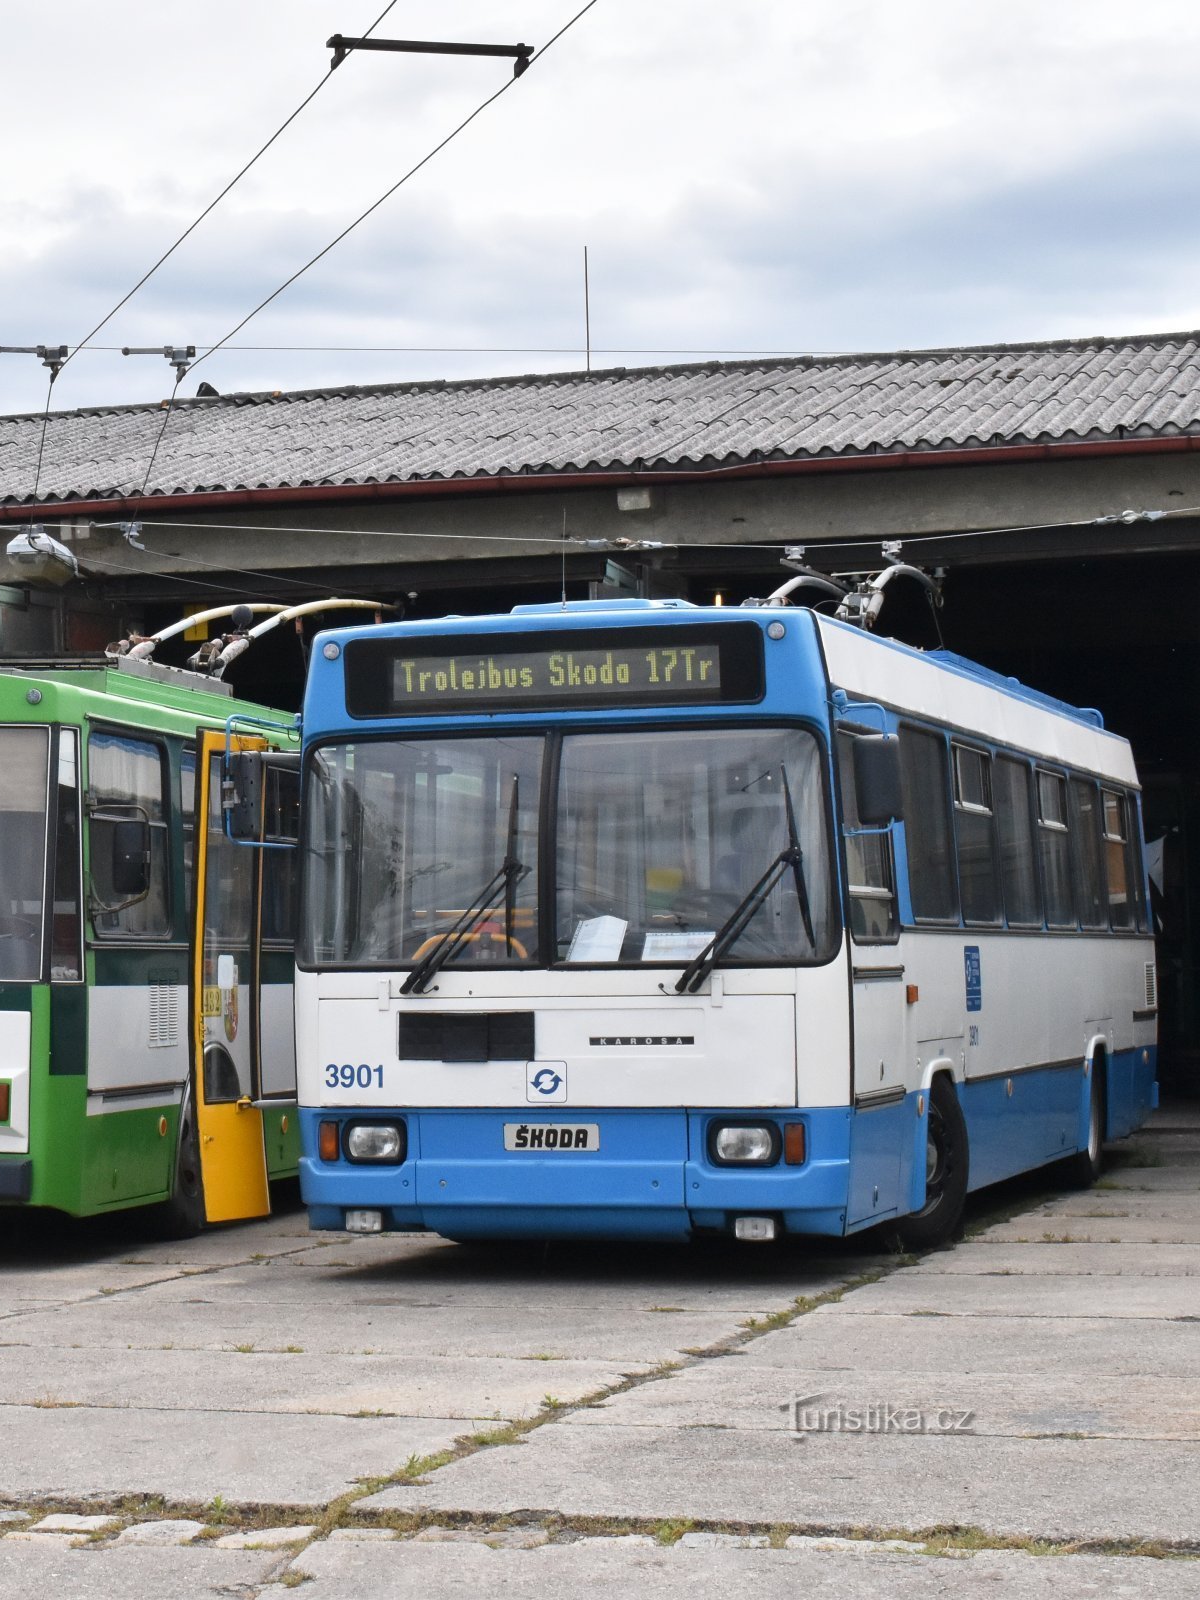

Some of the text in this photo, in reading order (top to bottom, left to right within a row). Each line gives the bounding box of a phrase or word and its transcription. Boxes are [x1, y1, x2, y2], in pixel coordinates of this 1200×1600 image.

[646, 649, 713, 682] 17Tr
[600, 1037, 682, 1045] KAROSA
[325, 1063, 383, 1089] 3901
[515, 1125, 588, 1148] ŠKODA
